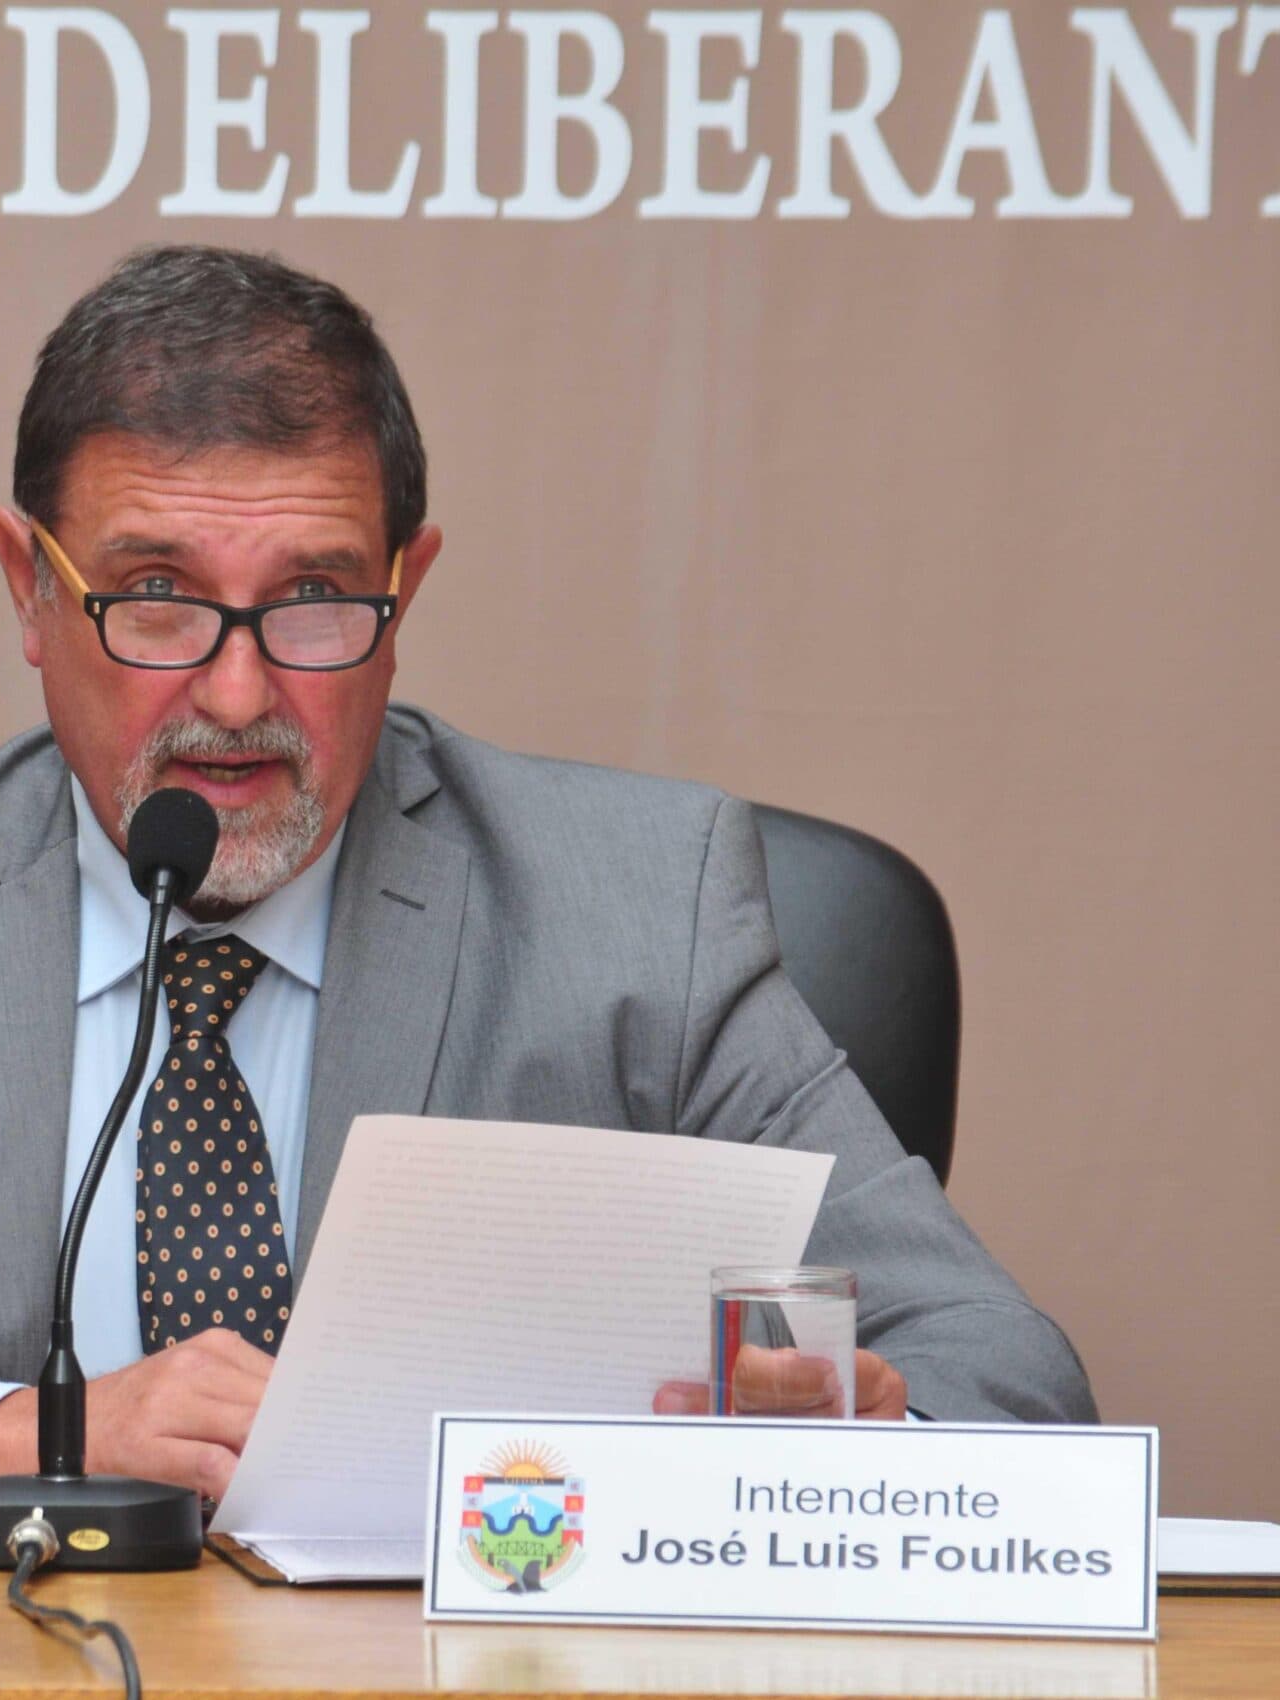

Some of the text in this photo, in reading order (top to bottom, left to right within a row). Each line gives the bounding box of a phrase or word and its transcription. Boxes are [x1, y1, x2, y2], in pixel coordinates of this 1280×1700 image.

[733, 1475, 1000, 1519] Intendente
[620, 1528, 1114, 1577] José Luis Foulkes
